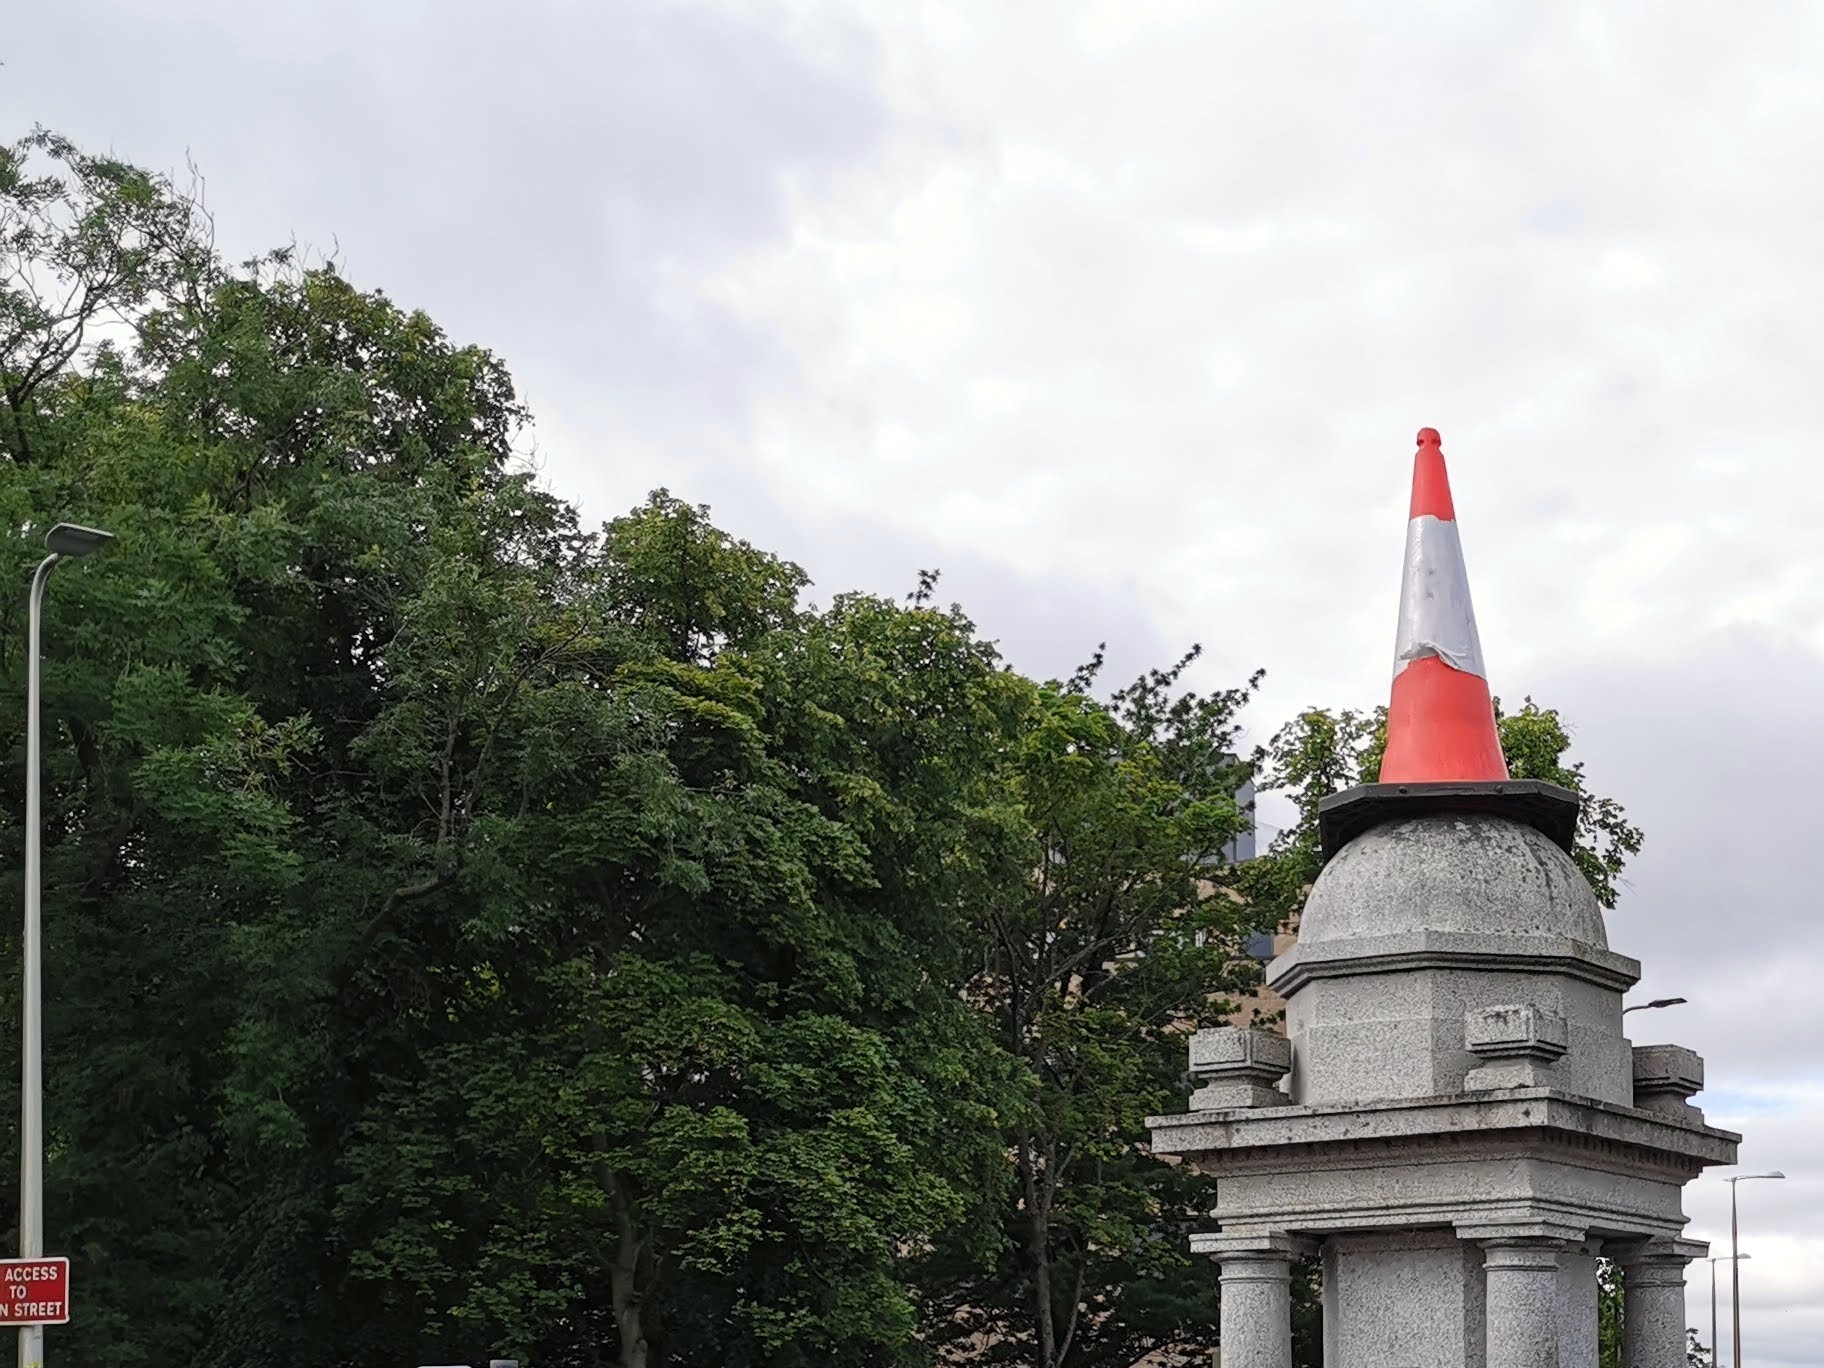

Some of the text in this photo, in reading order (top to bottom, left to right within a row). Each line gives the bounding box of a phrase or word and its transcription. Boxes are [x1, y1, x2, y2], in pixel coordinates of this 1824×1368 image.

[4, 1266, 58, 1282] ACCESS
[9, 1285, 27, 1300] TO
[14, 1301, 63, 1317] STREET
